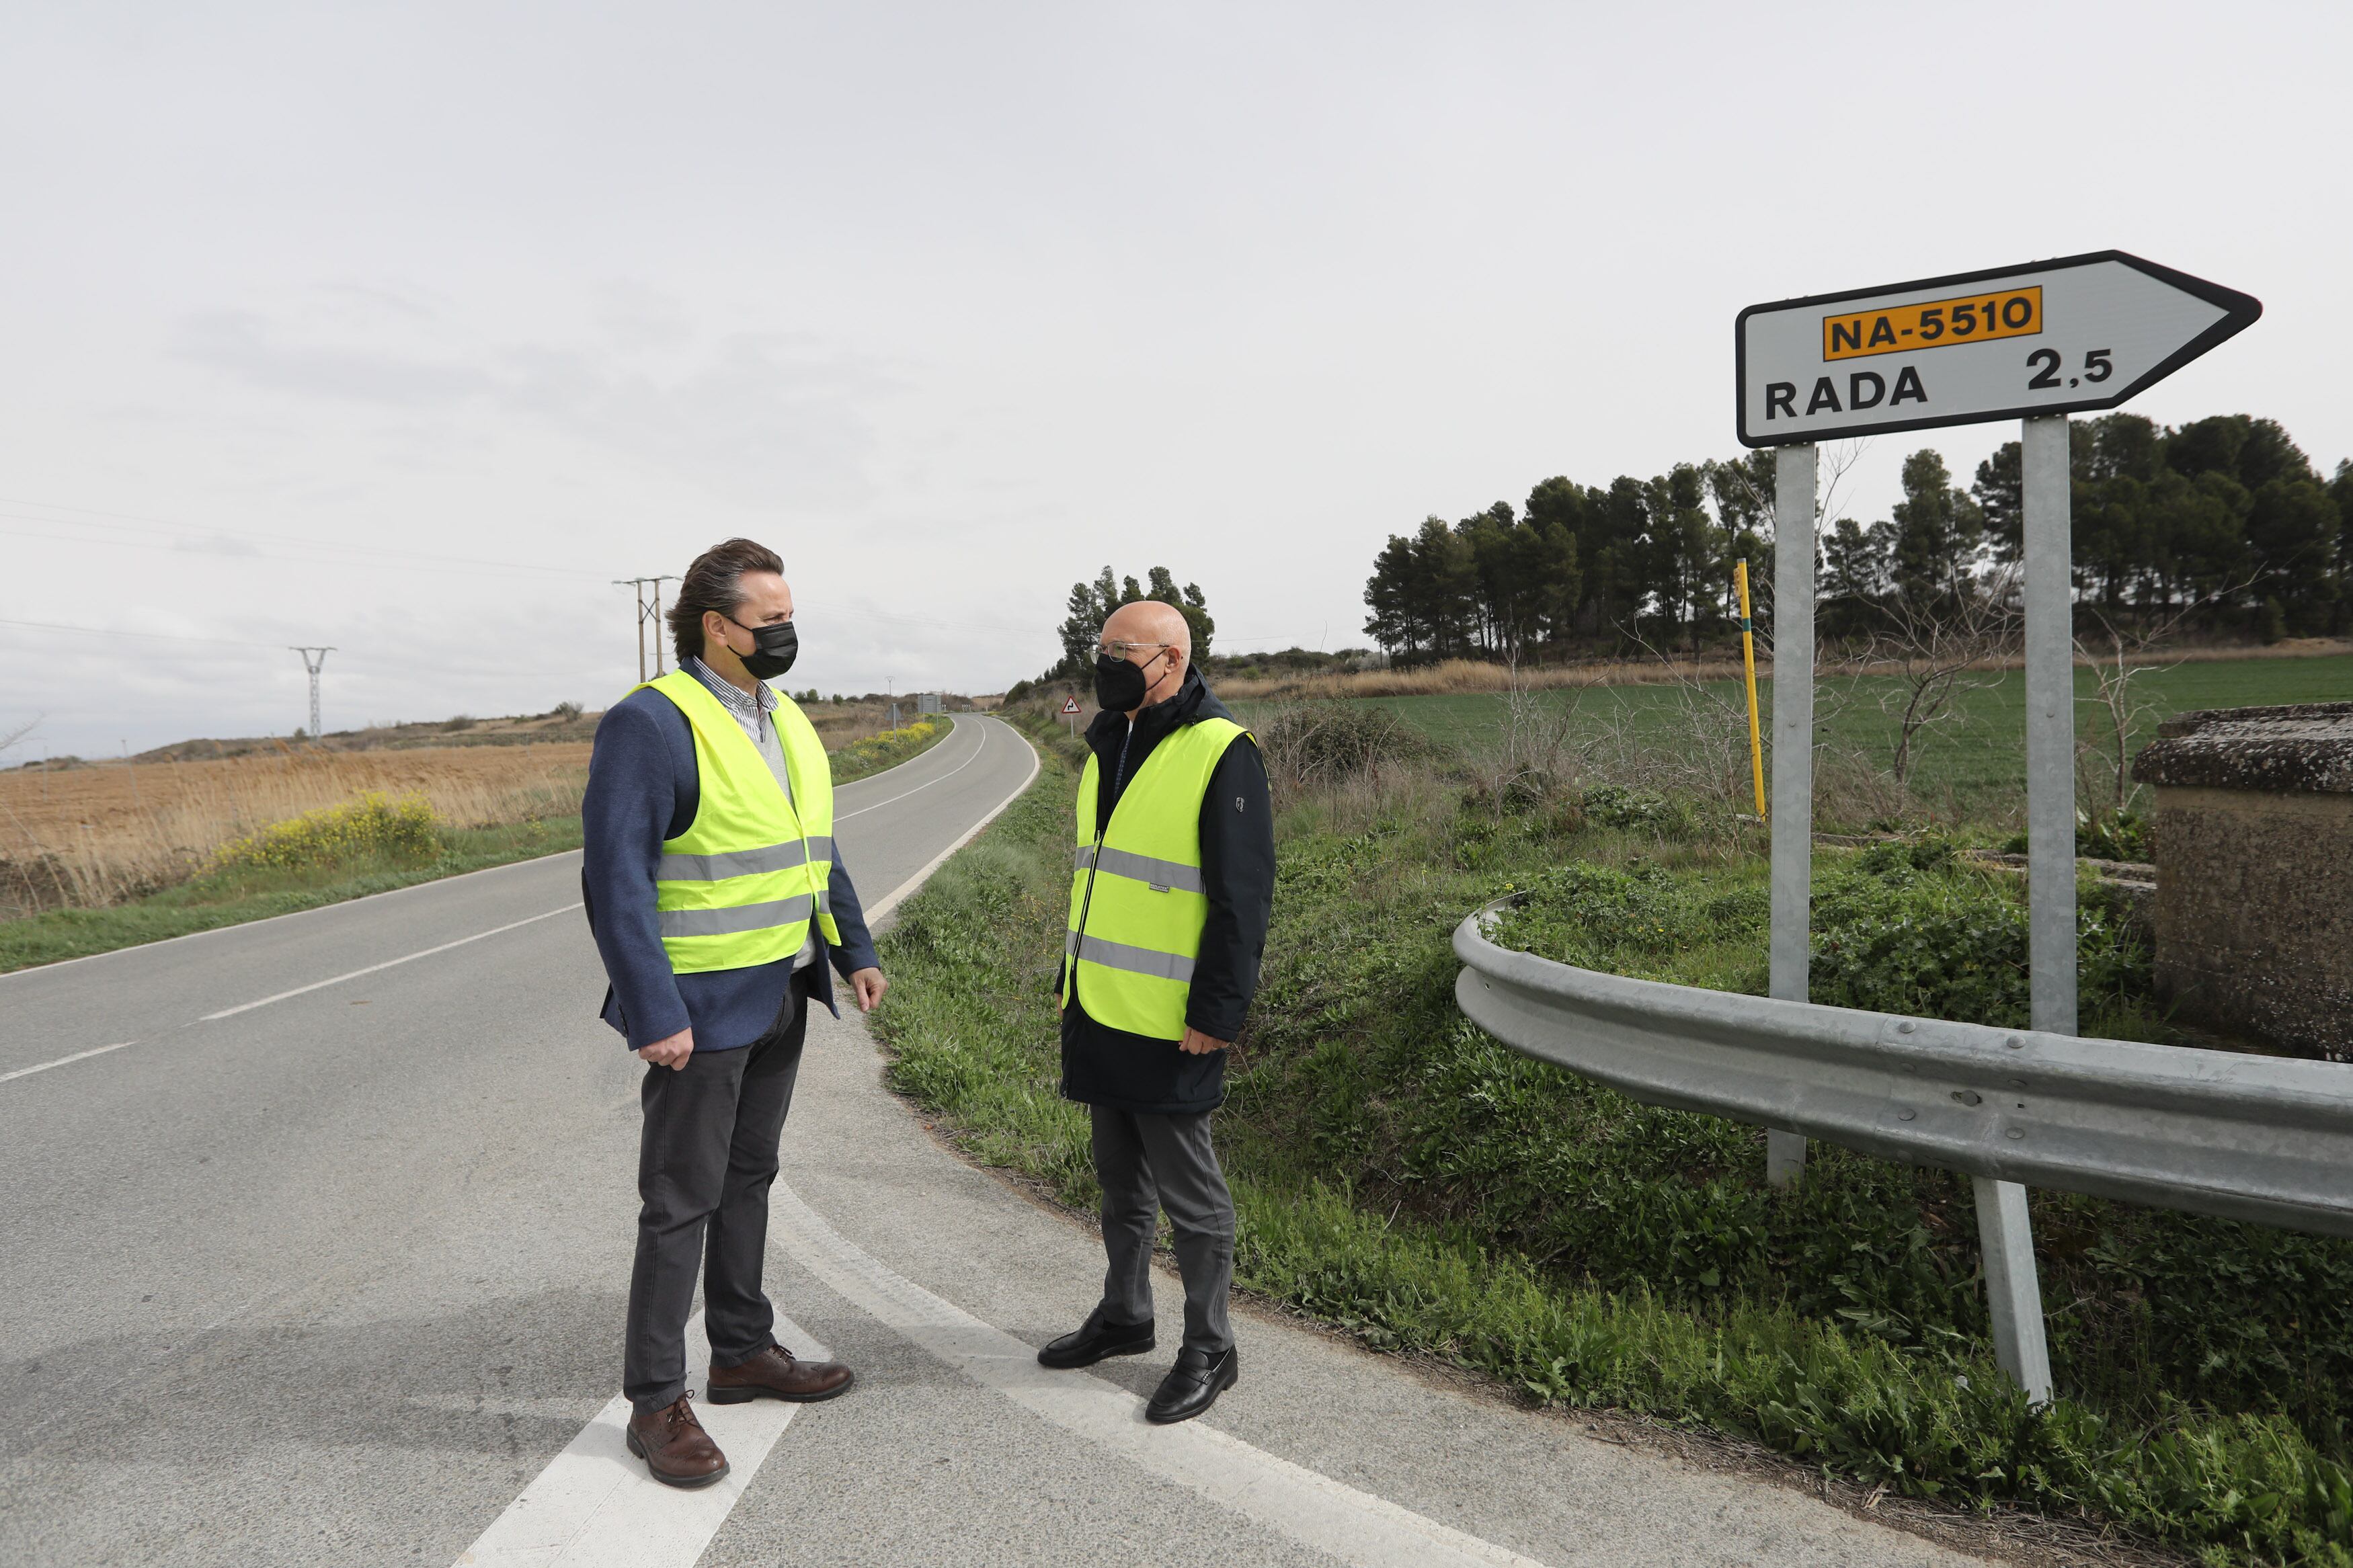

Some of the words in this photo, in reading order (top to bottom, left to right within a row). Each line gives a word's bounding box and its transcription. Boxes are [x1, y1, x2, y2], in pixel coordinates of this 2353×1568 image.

[1832, 296, 2032, 353] NA-5510
[1766, 366, 1928, 420] RADA
[2026, 348, 2112, 390] 2,5
